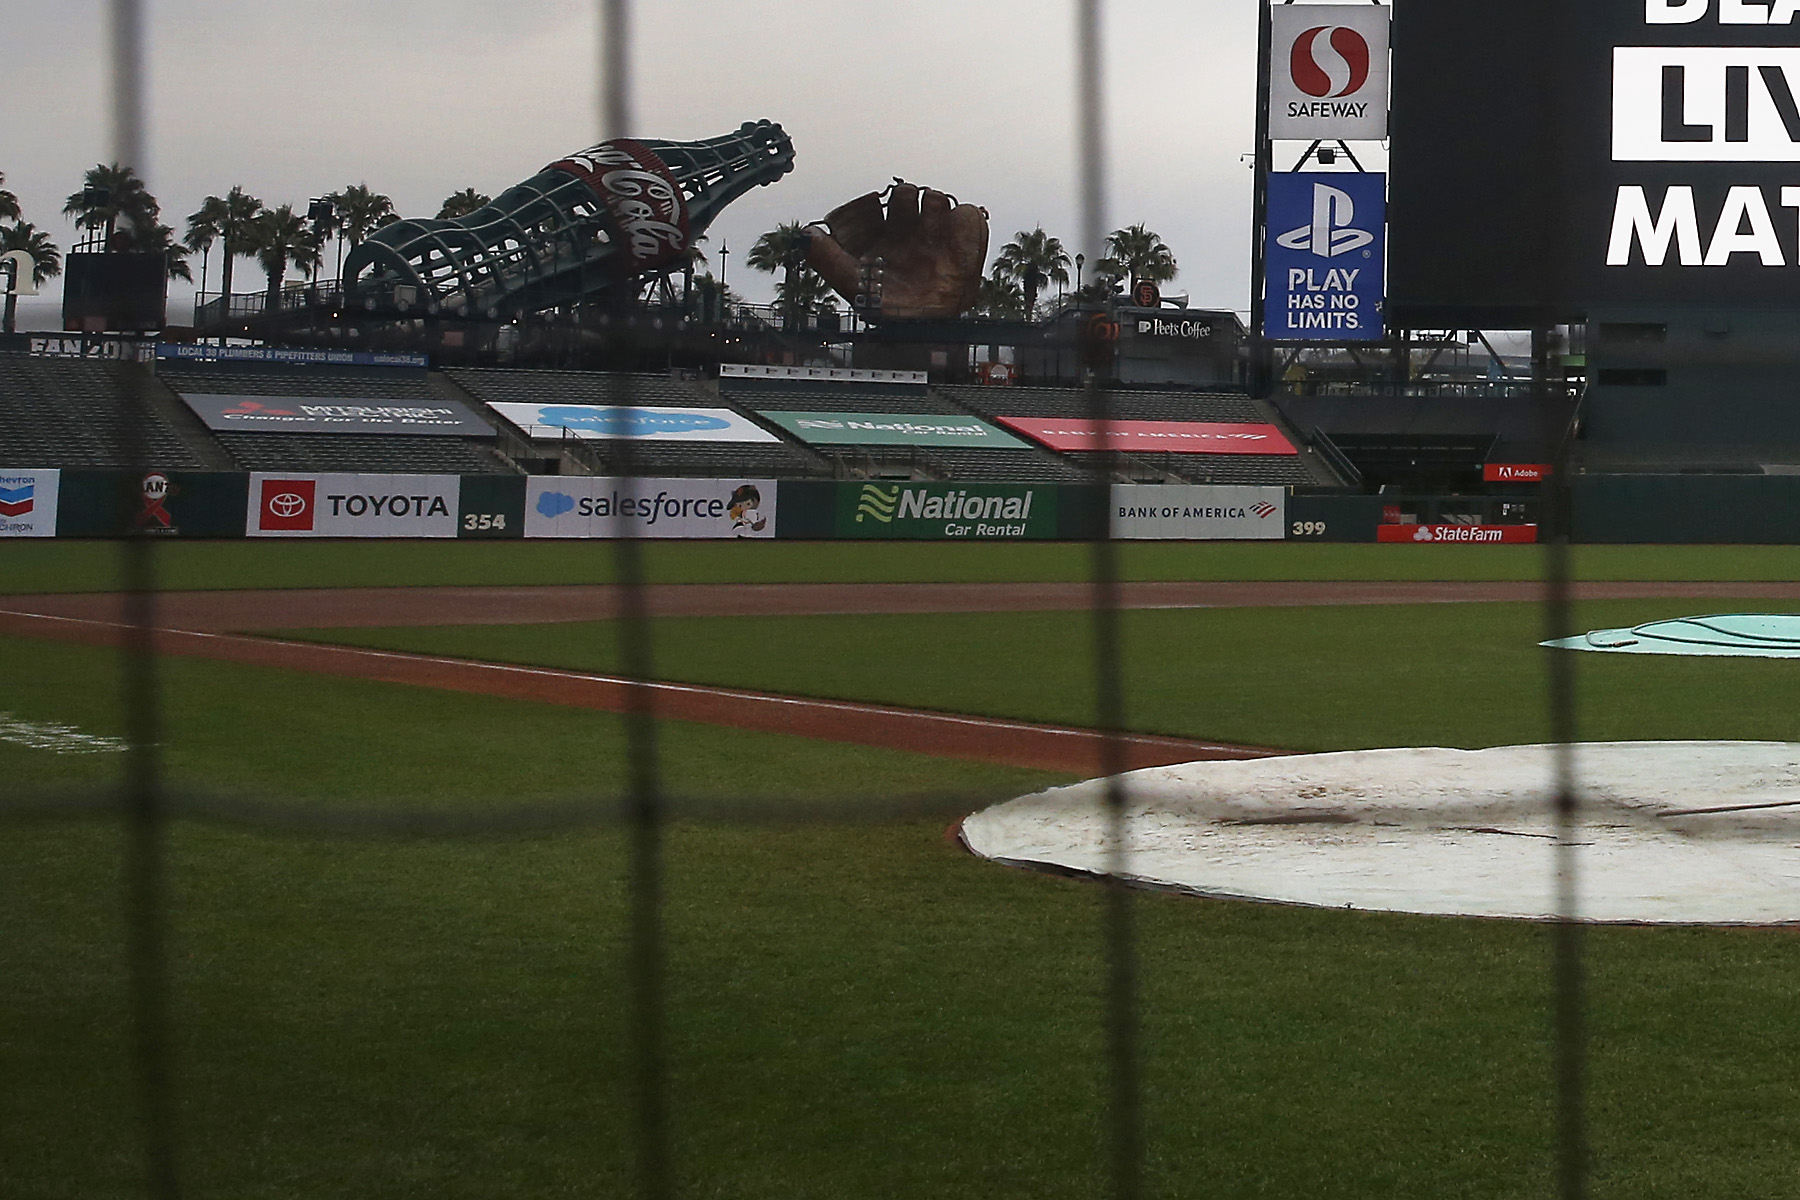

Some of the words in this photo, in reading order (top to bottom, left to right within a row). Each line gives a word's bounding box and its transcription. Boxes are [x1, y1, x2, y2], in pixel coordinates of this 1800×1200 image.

[1287, 102, 1368, 118] SAFEWAY
[1288, 268, 1360, 291] PLAY
[1288, 294, 1325, 309] HAS
[1330, 294, 1359, 309] NO
[1180, 320, 1211, 339] Coffee
[31, 338, 82, 354] FAN
[177, 347, 204, 356] LOCAL
[219, 348, 264, 359] PLUMBERS
[266, 350, 272, 360] &
[275, 350, 326, 362] PIPEFITTERS
[328, 352, 353, 362] UNION
[847, 420, 985, 433] National
[0, 476, 35, 484] hevron
[1513, 468, 1539, 478] Adobe
[327, 494, 449, 517] TOYOTA
[578, 491, 724, 525] salesforce
[897, 489, 1033, 519] National
[1118, 507, 1157, 518] BANK
[1161, 507, 1179, 518] OF
[1183, 507, 1246, 518] AMERICA
[464, 514, 506, 530] 354
[945, 523, 971, 536] Car
[976, 523, 1025, 536] Rental
[1292, 521, 1326, 535] 399
